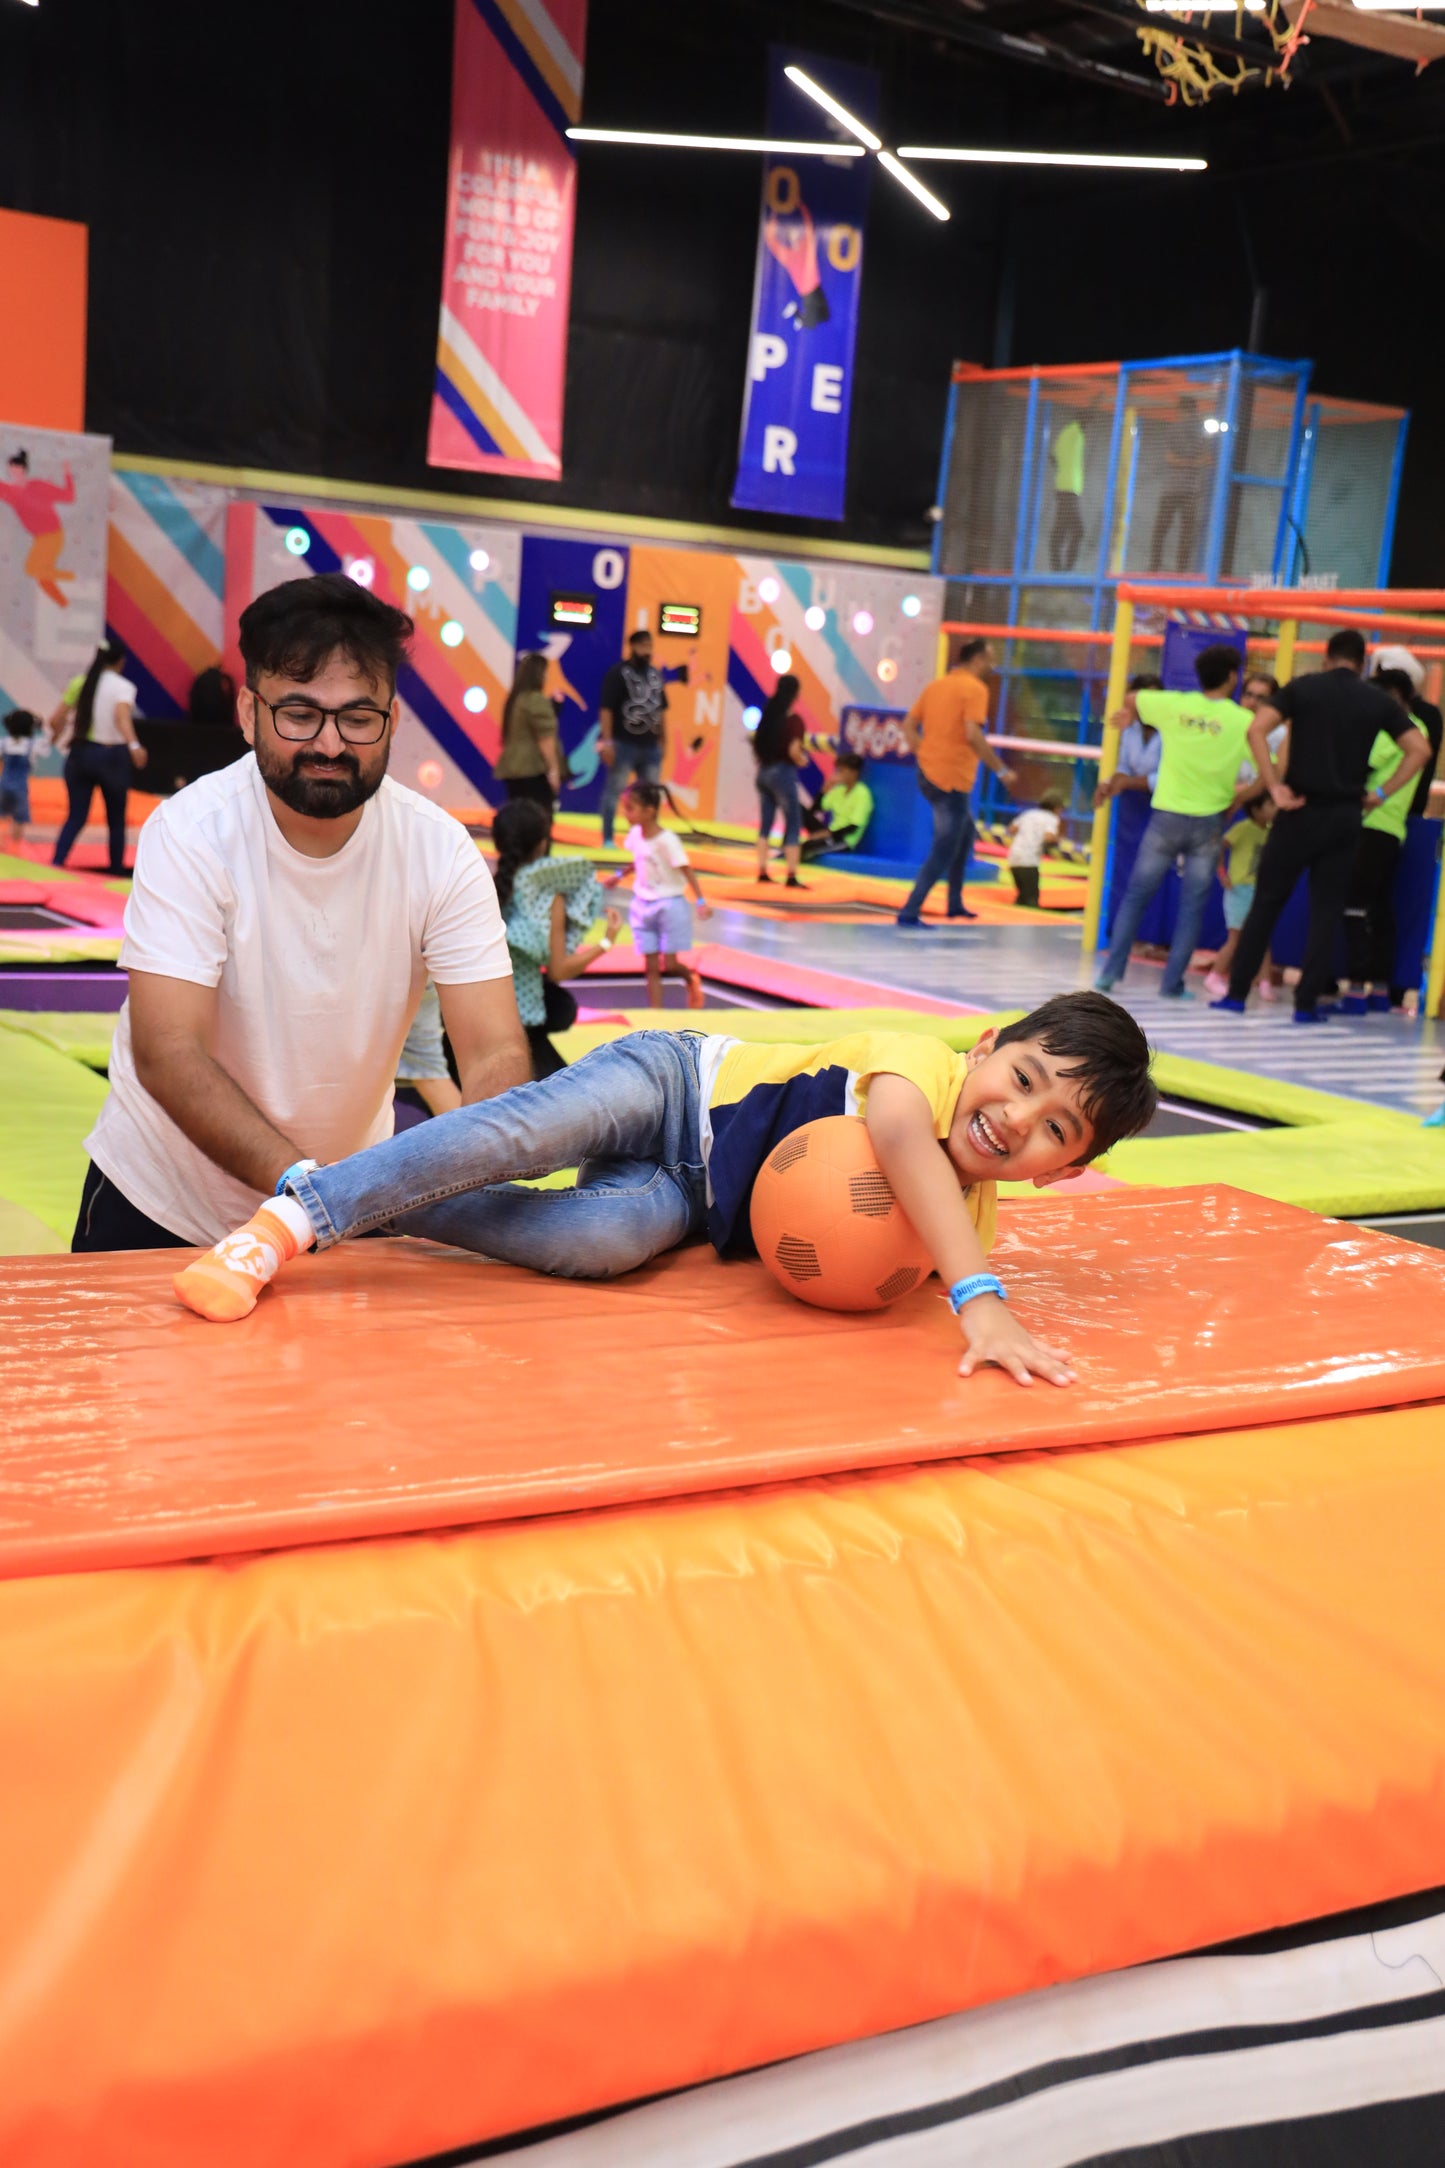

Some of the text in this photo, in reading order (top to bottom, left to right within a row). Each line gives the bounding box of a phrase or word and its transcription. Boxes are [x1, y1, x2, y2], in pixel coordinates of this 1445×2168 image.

[509, 250, 551, 274] YOU
[455, 264, 556, 299] AND YOUR
[465, 288, 541, 317] FAMILY
